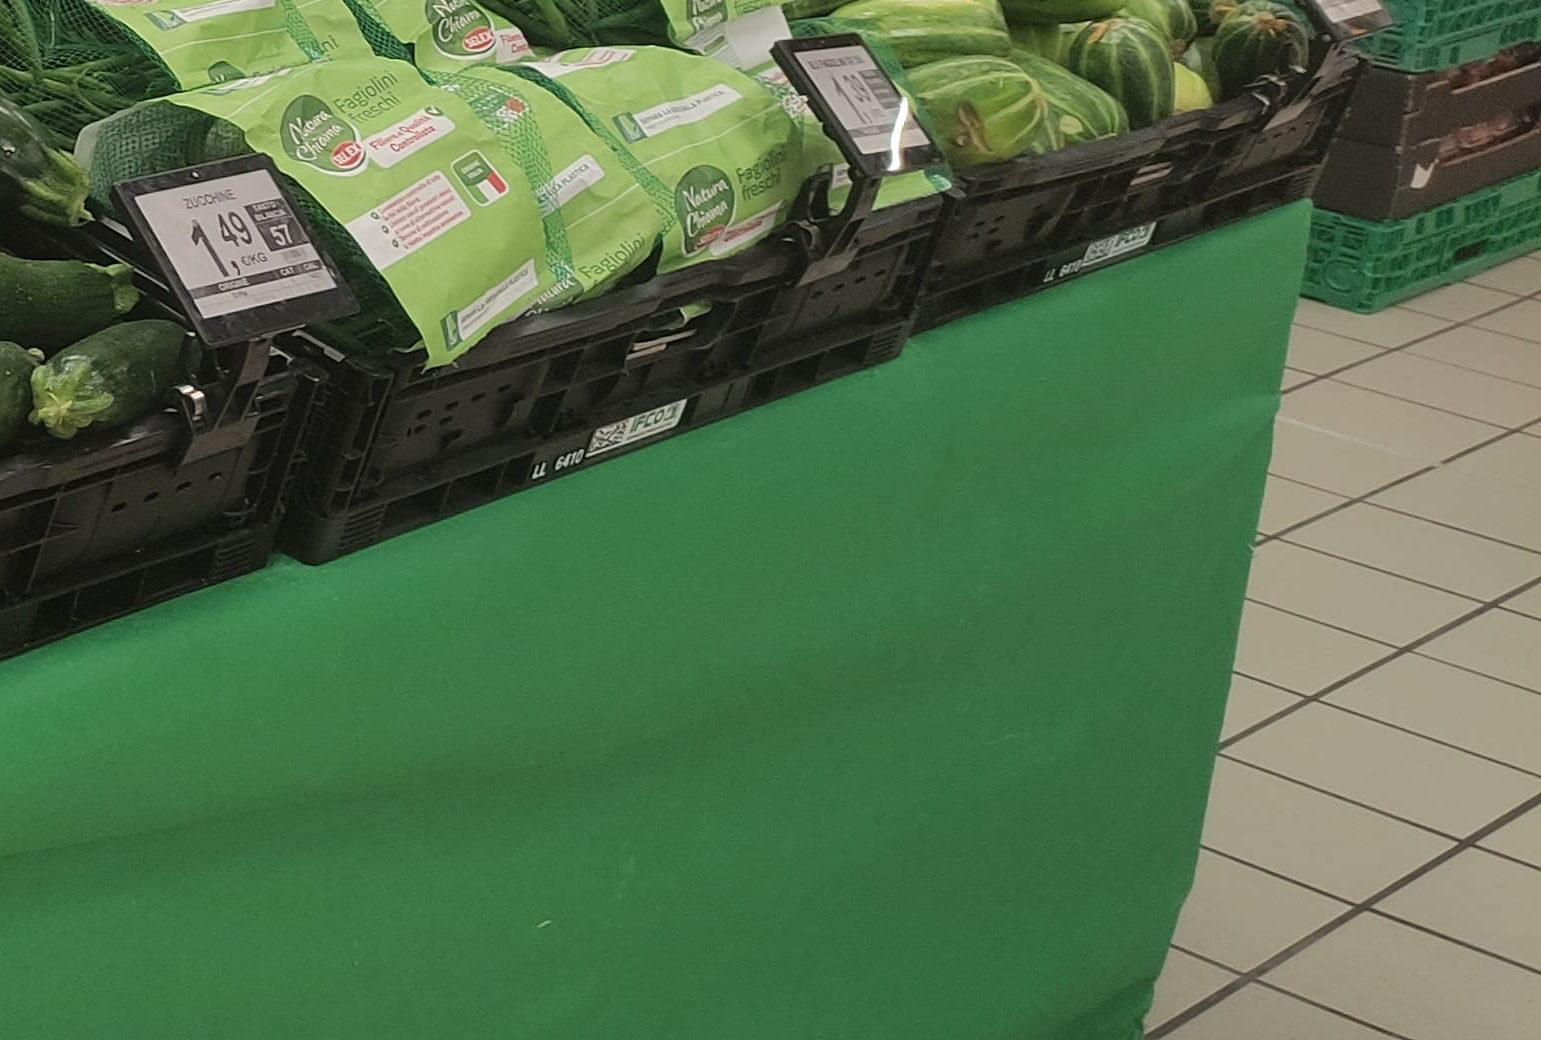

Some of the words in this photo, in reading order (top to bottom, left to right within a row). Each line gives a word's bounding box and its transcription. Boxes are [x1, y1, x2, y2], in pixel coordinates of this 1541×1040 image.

[333, 72, 399, 115] Fagiolini
[348, 90, 403, 125] freschi
[288, 110, 335, 146] Natura
[296, 122, 345, 160] Chiama
[368, 131, 399, 152] Filiera
[390, 123, 437, 153] Controllata
[182, 188, 238, 210] ZUCCHINE
[682, 177, 731, 212] Natura
[268, 223, 295, 247] 57
[686, 199, 729, 238] Chiama
[190, 211, 254, 278] 1,49
[240, 251, 269, 267] €/KG
[579, 231, 647, 281] Fagiolini
[531, 462, 547, 480] LL
[554, 448, 585, 471] 6410
[629, 408, 663, 434] IFCO
